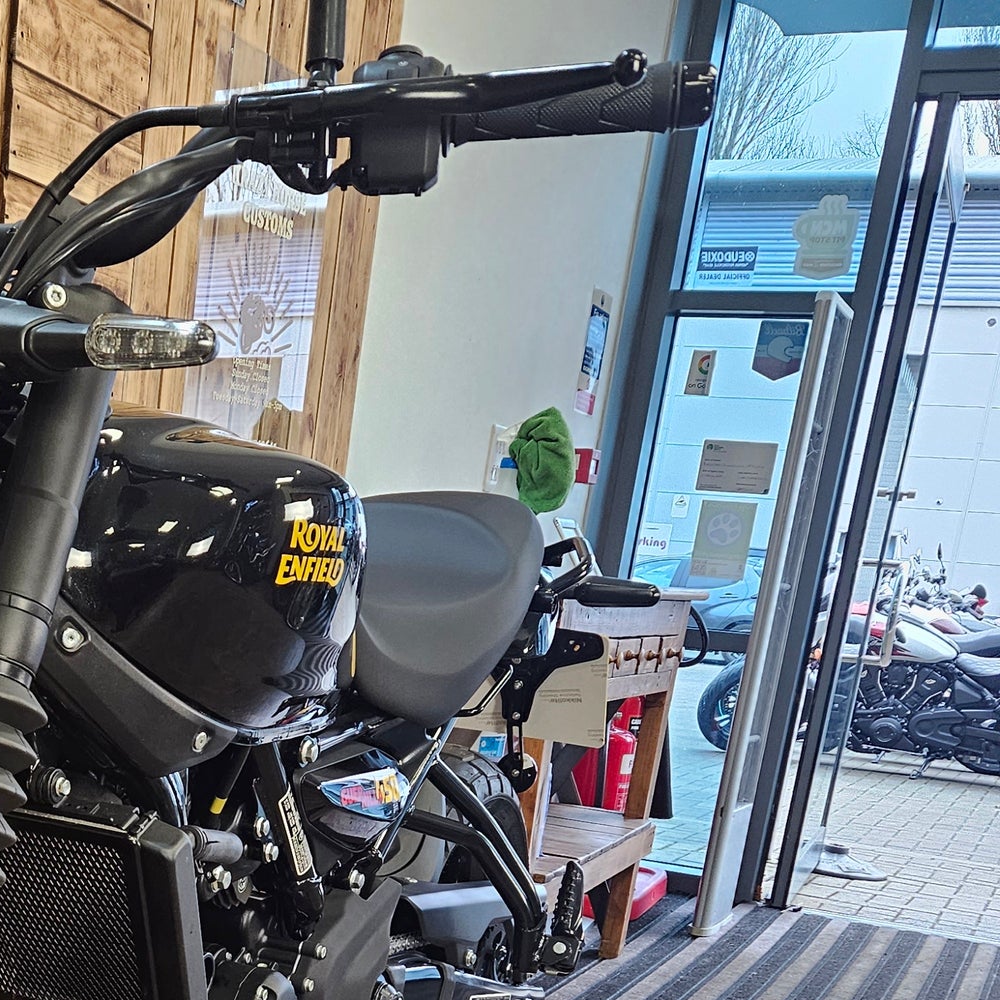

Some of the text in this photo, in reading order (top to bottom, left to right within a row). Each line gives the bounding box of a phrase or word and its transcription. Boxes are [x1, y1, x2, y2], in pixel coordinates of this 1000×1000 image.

[242, 202, 295, 240] CUSTOMS
[290, 519, 346, 553] ROYAL
[637, 536, 667, 550] rking
[274, 554, 346, 587] ENFIELD
